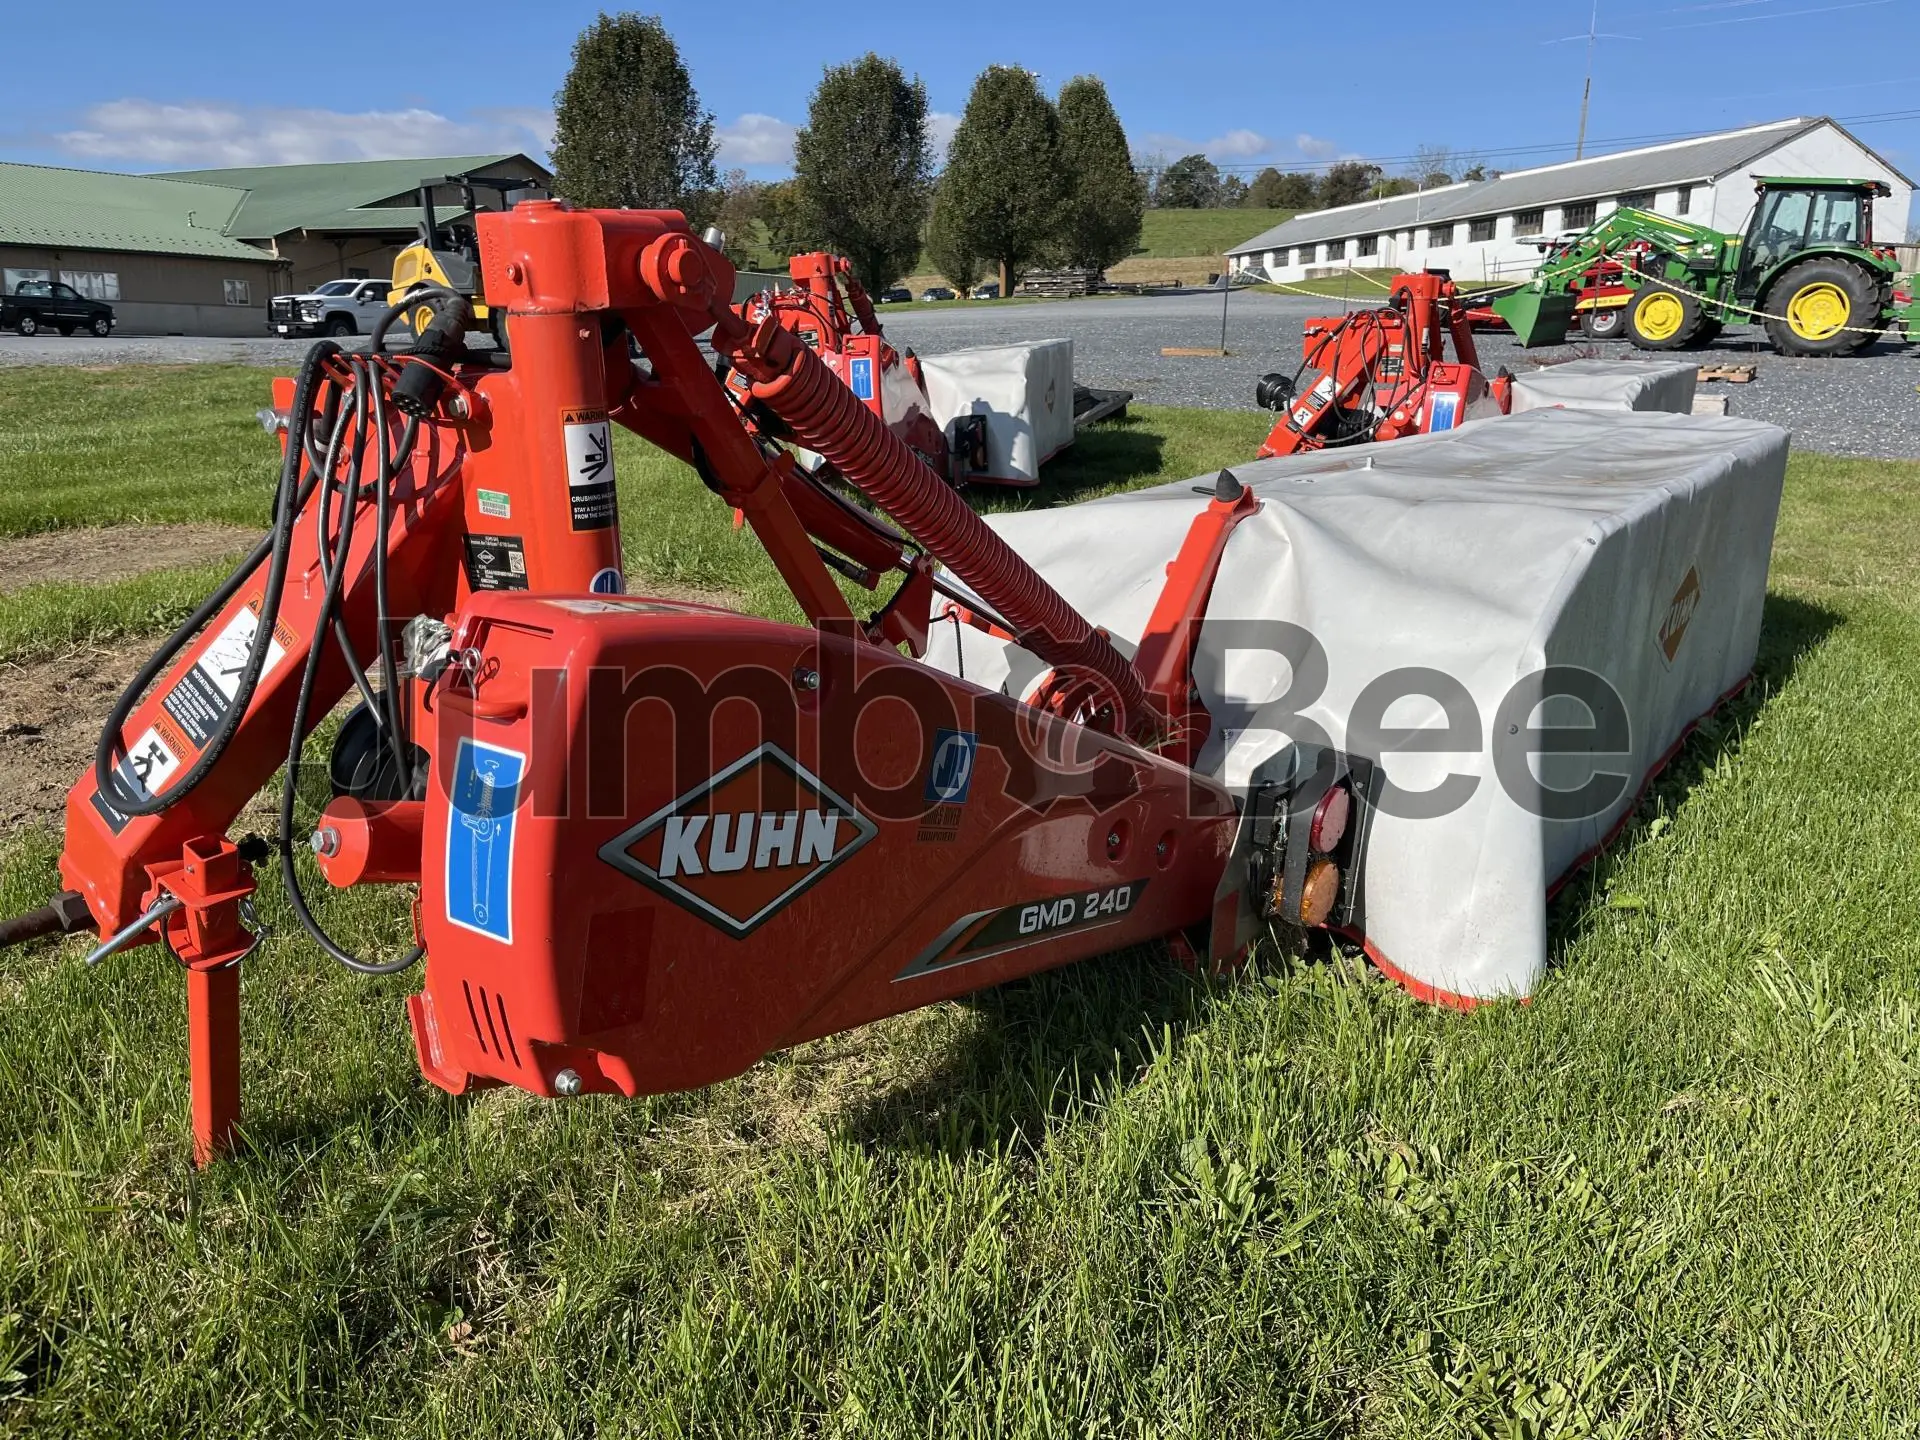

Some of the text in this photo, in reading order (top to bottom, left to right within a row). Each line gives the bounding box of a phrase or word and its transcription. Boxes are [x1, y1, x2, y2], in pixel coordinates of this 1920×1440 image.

[164, 698, 176, 712] FROM
[182, 677, 200, 698] OBJECTS
[192, 669, 214, 695] ROTATING
[212, 692, 228, 711] TOOLS
[160, 726, 186, 760] WARNING
[658, 808, 840, 879] KUHN
[1019, 886, 1131, 934] GMD 240
